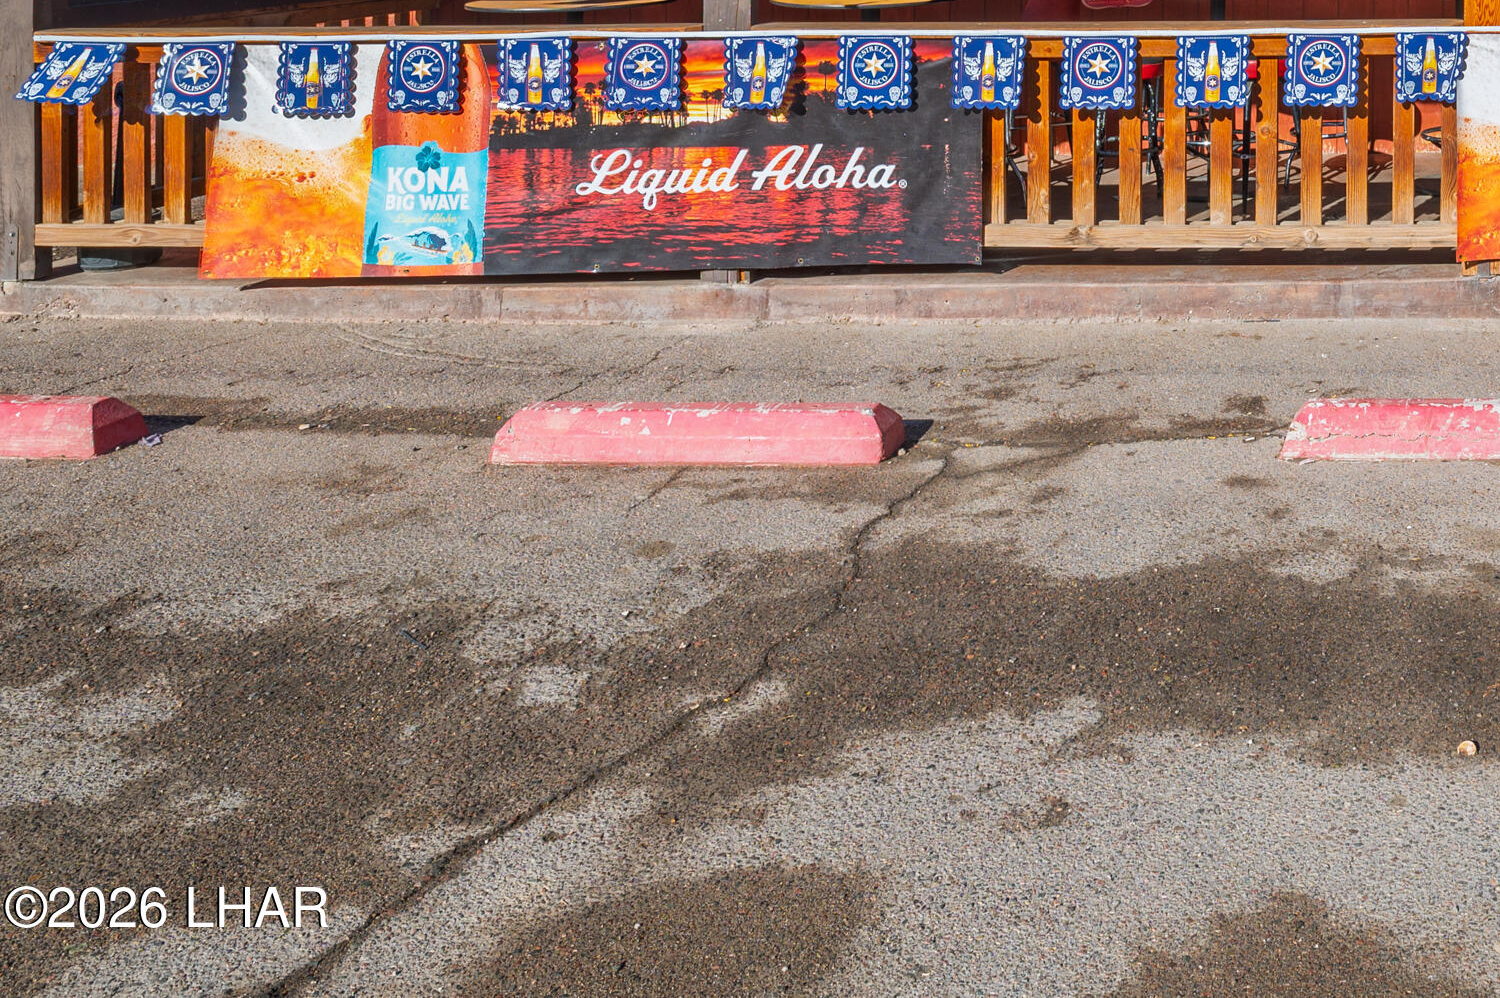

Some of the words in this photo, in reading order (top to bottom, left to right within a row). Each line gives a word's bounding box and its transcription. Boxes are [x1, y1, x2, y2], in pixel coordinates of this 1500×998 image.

[406, 51, 439, 64] ESTRELLA
[627, 49, 661, 62] ESTRELLA
[856, 46, 892, 60] ESTRELLA
[1082, 47, 1117, 61] ESTRELLA
[1306, 44, 1340, 58] ESTRELLA
[179, 52, 216, 68] ESTRELLA
[859, 76, 889, 85] JALISCO
[1085, 76, 1114, 86] JALISCO
[1309, 72, 1337, 82] JALISCO
[179, 80, 210, 91] JALISCO
[386, 166, 470, 196] KONA
[575, 148, 749, 211] Liquid
[385, 194, 415, 211] BIG
[418, 193, 470, 211] WAVE
